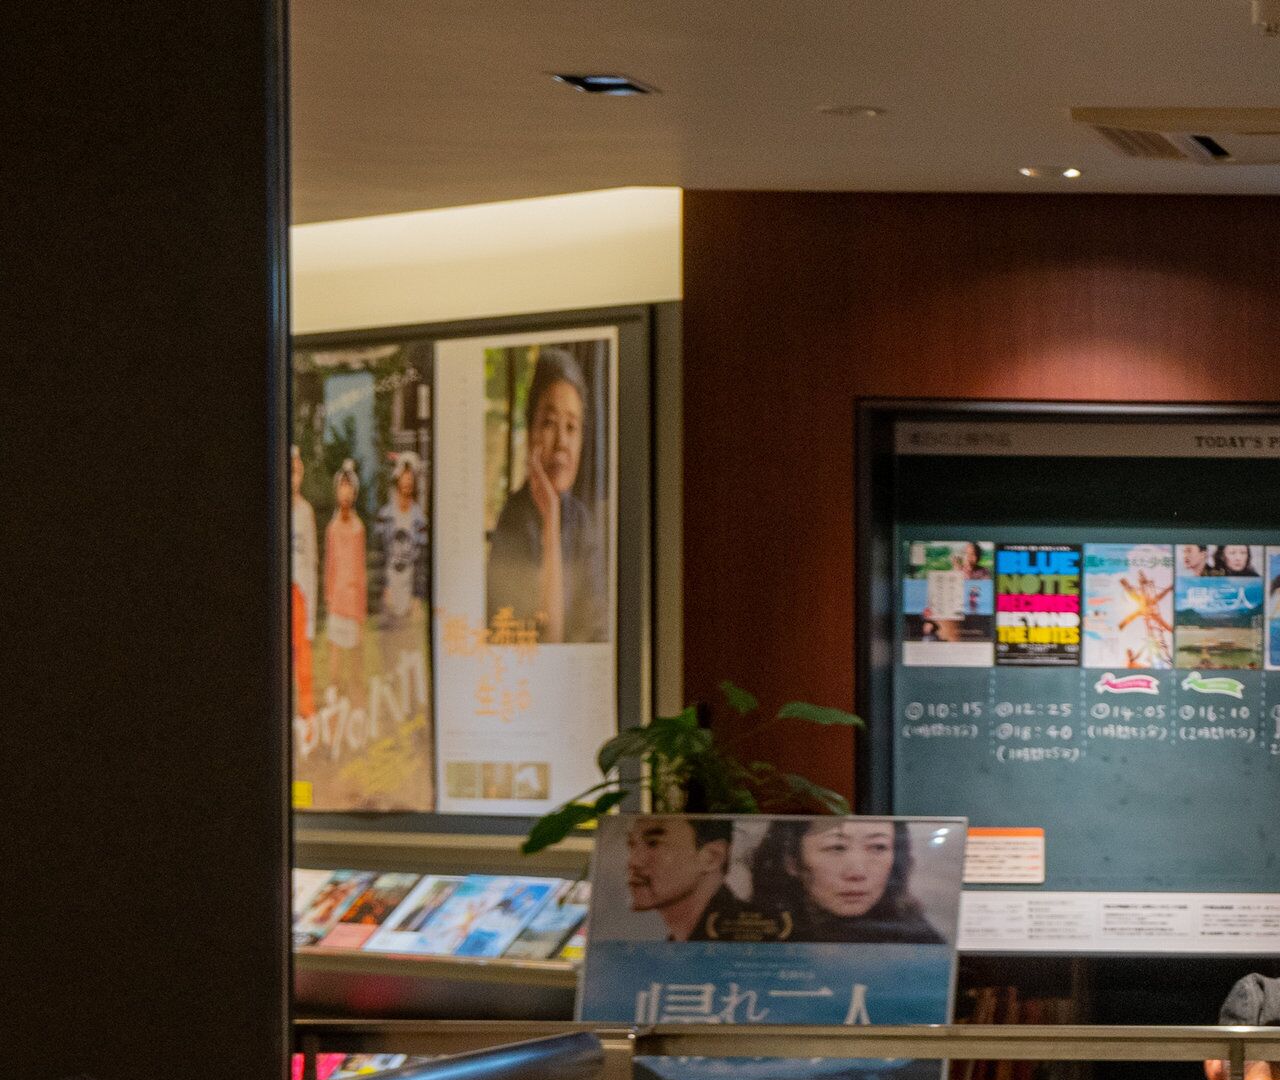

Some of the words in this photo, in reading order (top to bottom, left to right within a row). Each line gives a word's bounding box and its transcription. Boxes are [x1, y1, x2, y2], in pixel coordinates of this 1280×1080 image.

[1194, 436, 1263, 449] TODAY'S
[997, 551, 1080, 575] BLUE
[997, 574, 1080, 595] NOTE
